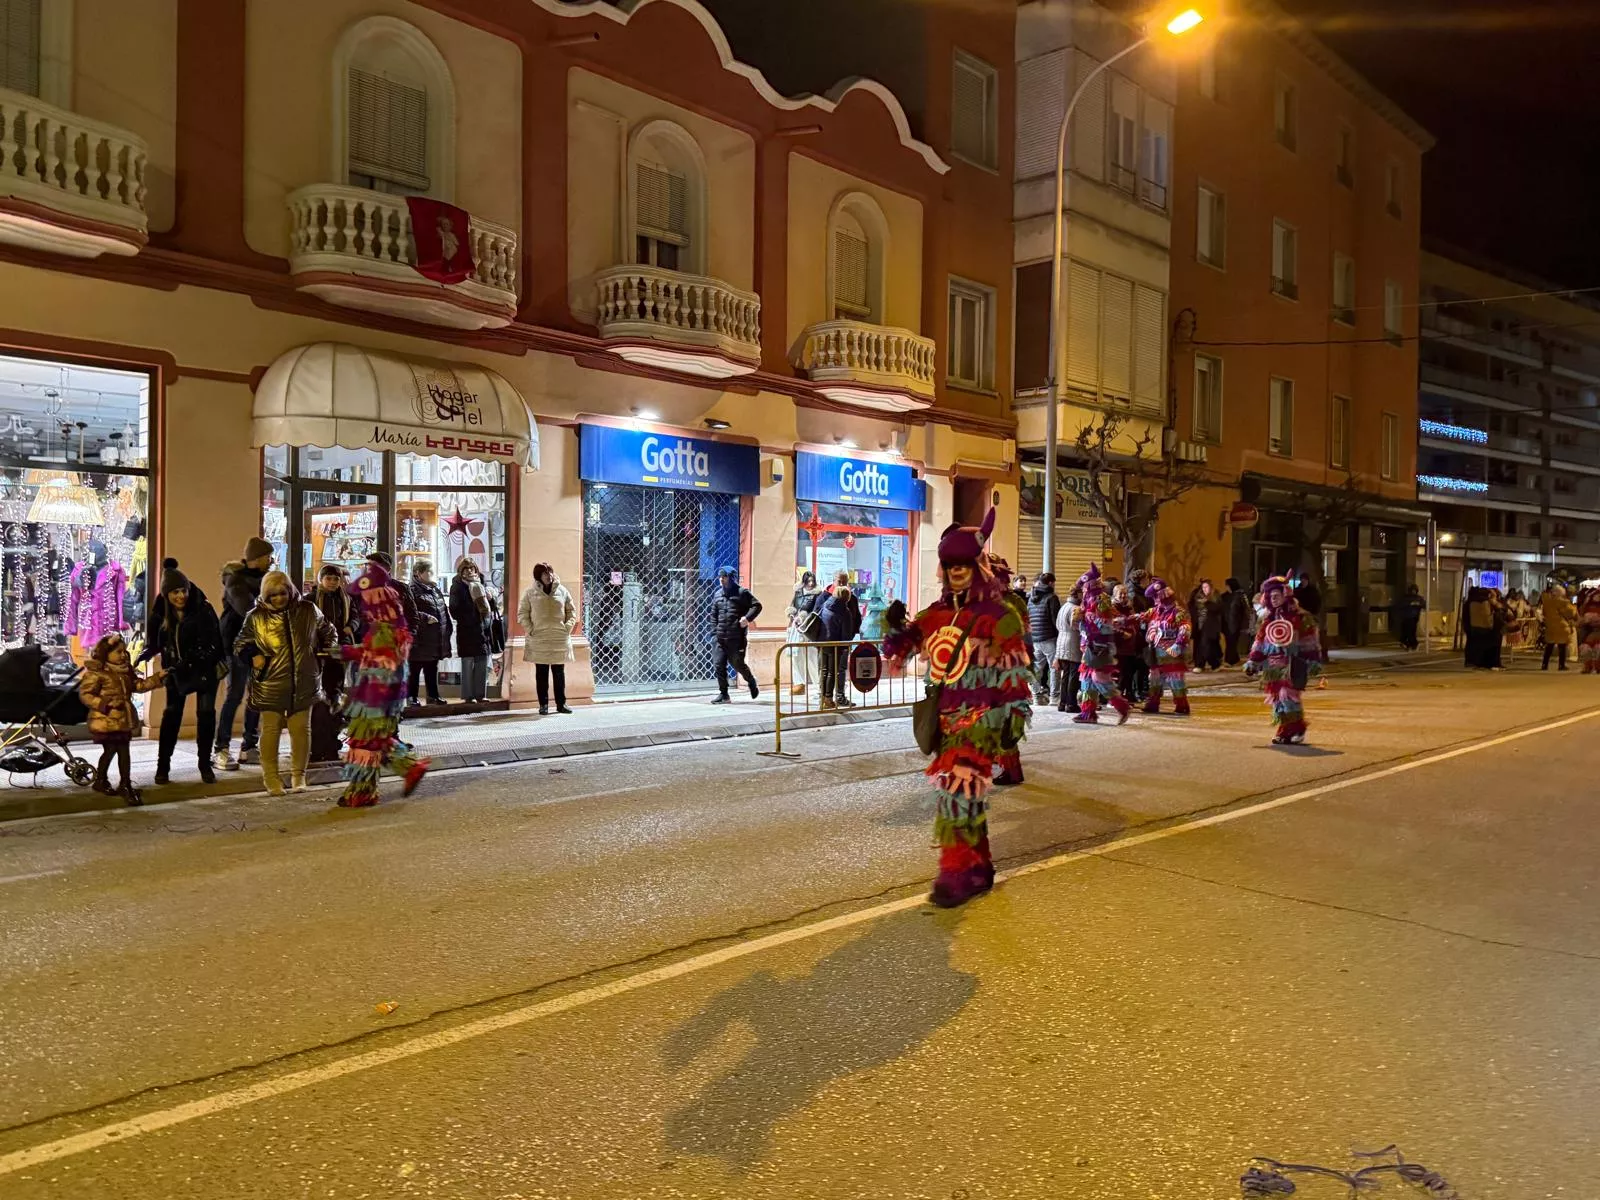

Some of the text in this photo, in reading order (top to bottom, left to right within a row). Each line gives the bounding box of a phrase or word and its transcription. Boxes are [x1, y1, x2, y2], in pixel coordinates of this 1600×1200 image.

[427, 384, 478, 406] Hogar
[450, 405, 482, 425] Piel
[368, 426, 421, 447] María
[641, 436, 709, 477] Gotta
[840, 461, 889, 497] Gotta
